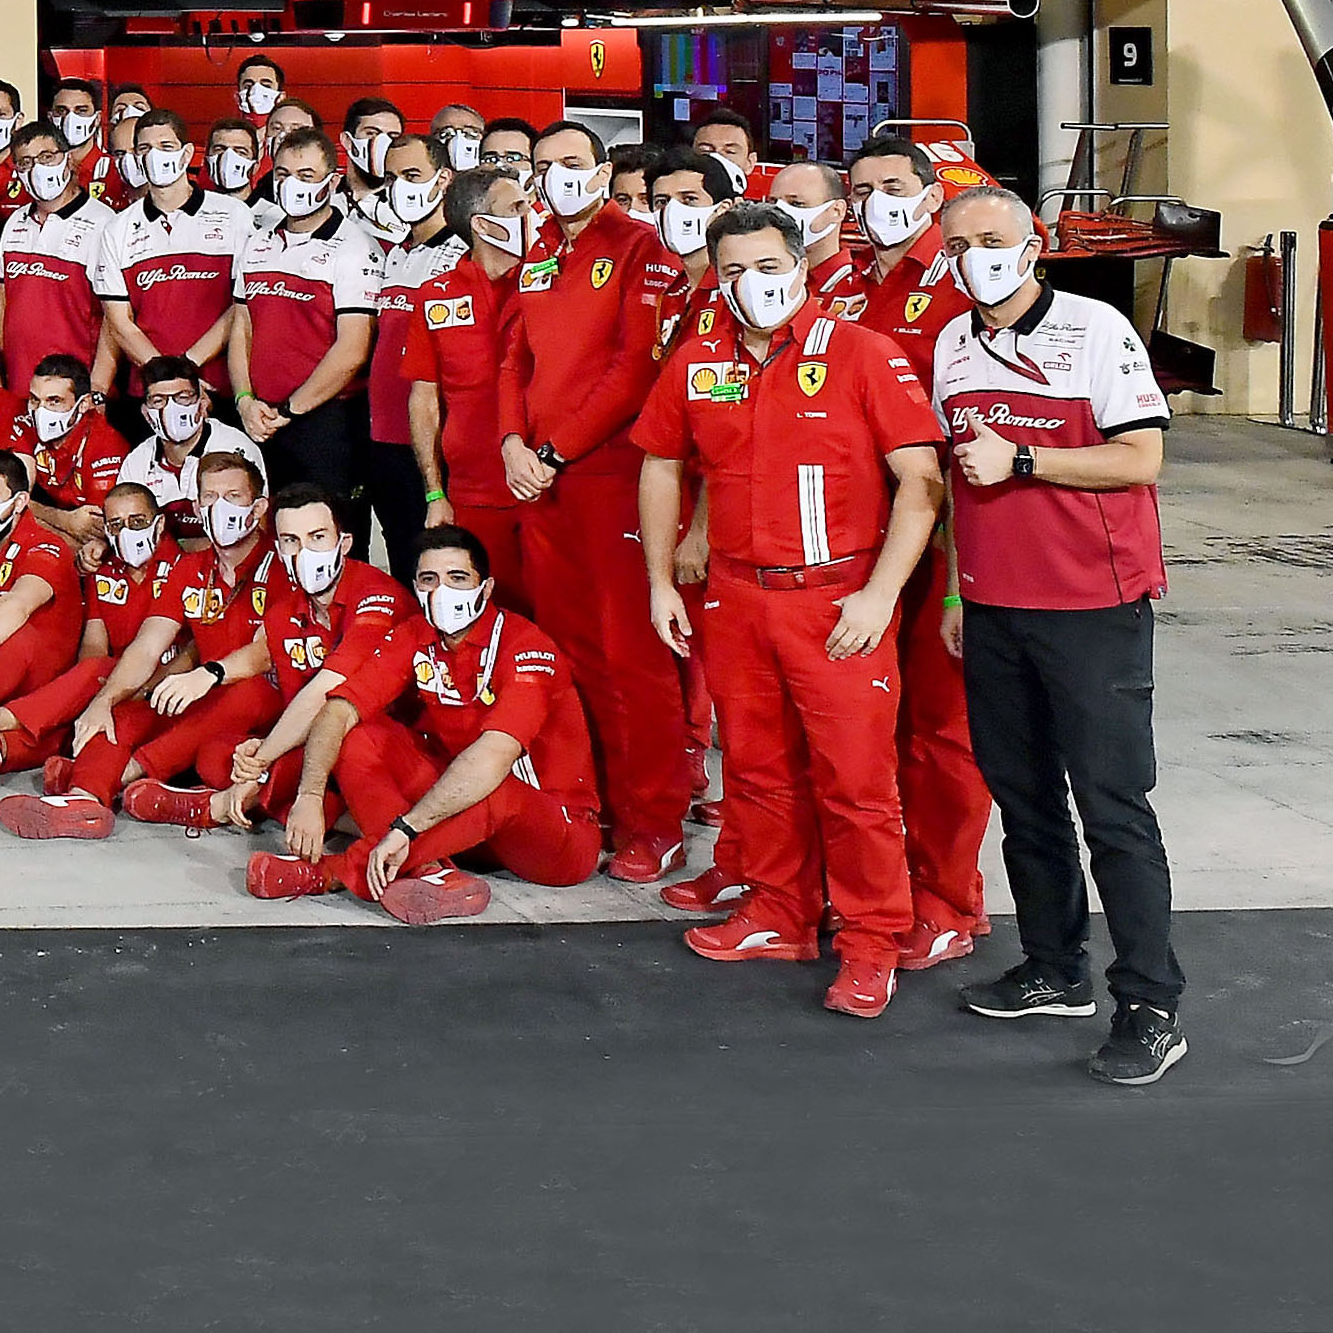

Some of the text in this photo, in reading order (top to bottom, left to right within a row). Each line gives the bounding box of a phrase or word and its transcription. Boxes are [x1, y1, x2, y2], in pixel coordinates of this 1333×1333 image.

[1123, 42, 1138, 67] 9
[136, 265, 220, 291] Alfa Romeo
[646, 263, 679, 278] HUBLO
[984, 403, 1066, 429] Romeo
[515, 651, 556, 662] HUBLOT
